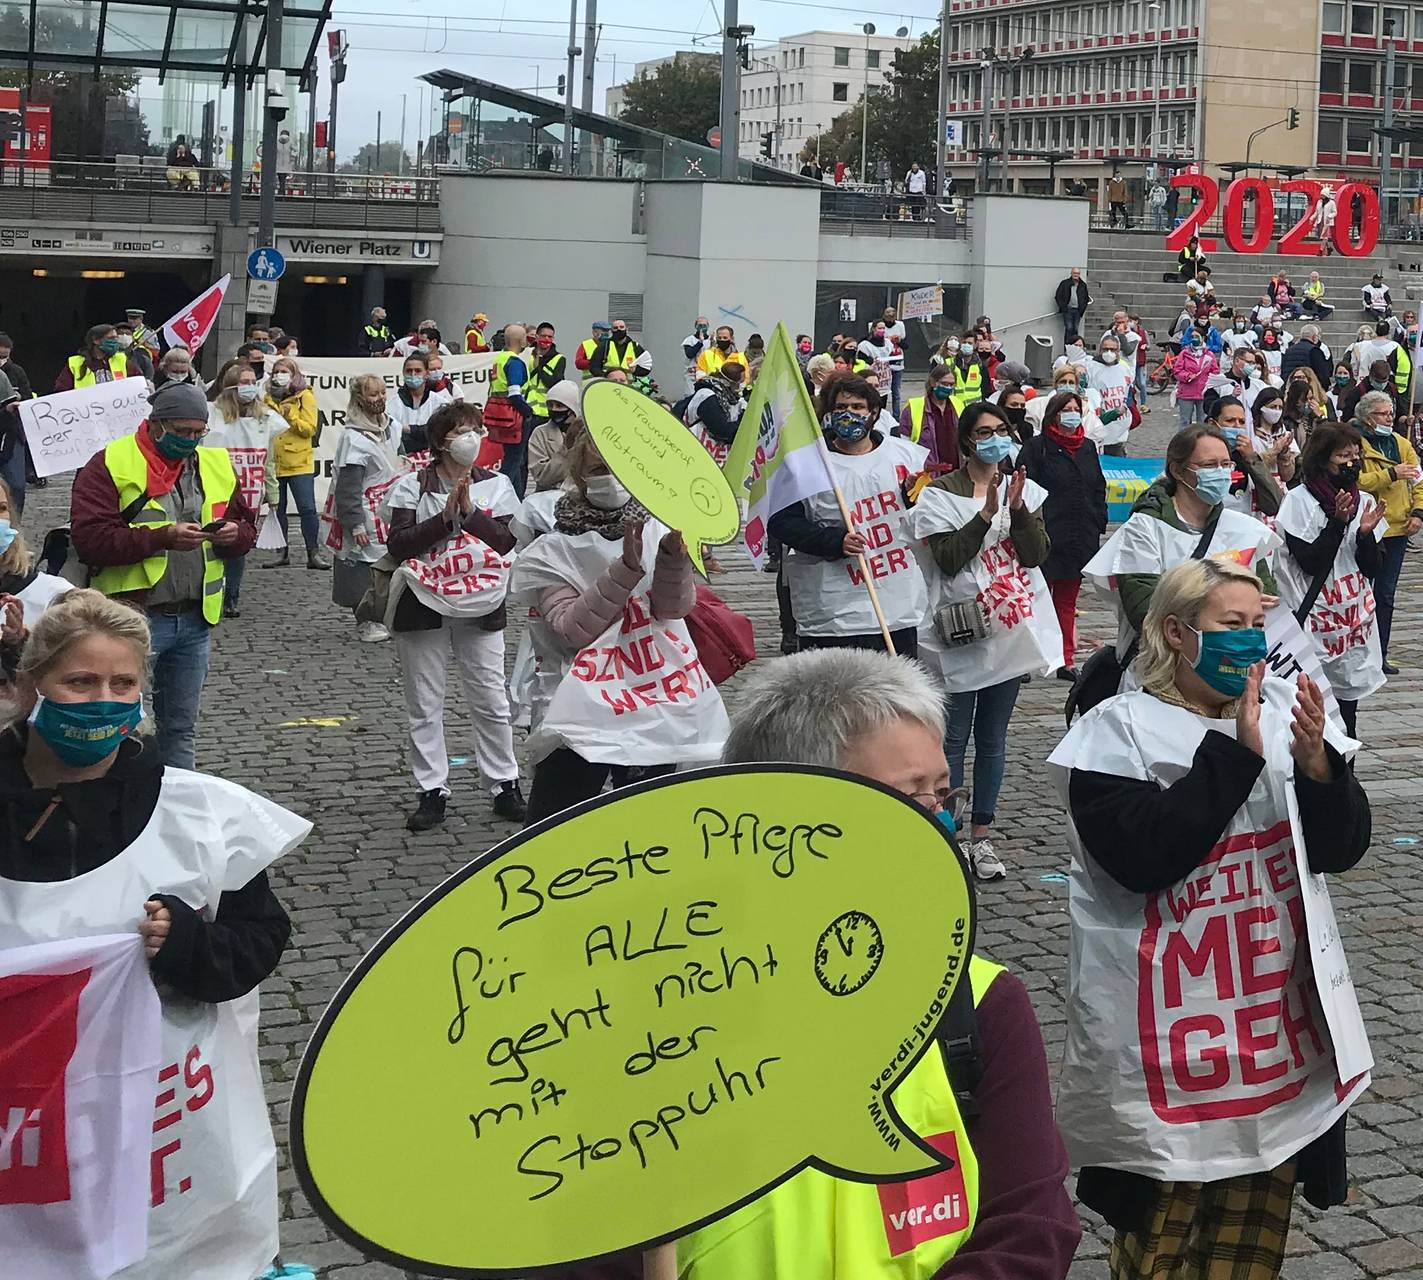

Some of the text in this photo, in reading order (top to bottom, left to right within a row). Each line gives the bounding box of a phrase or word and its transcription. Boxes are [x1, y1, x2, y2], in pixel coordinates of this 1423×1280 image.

[289, 239, 353, 256] Wiener
[359, 241, 401, 257] Platz
[1165, 174, 1380, 257] 2020
[30, 402, 105, 430] Raus
[571, 634, 666, 683] SIND
[494, 806, 844, 931] Beste Pflege
[447, 900, 724, 1044] für ALLE
[485, 943, 778, 1086] geht nicht
[468, 1026, 718, 1139] mit der
[867, 917, 966, 1153] www.verdi-jugend.de
[516, 1056, 782, 1202] Stoppuhr
[888, 1193, 961, 1232] ver.di
